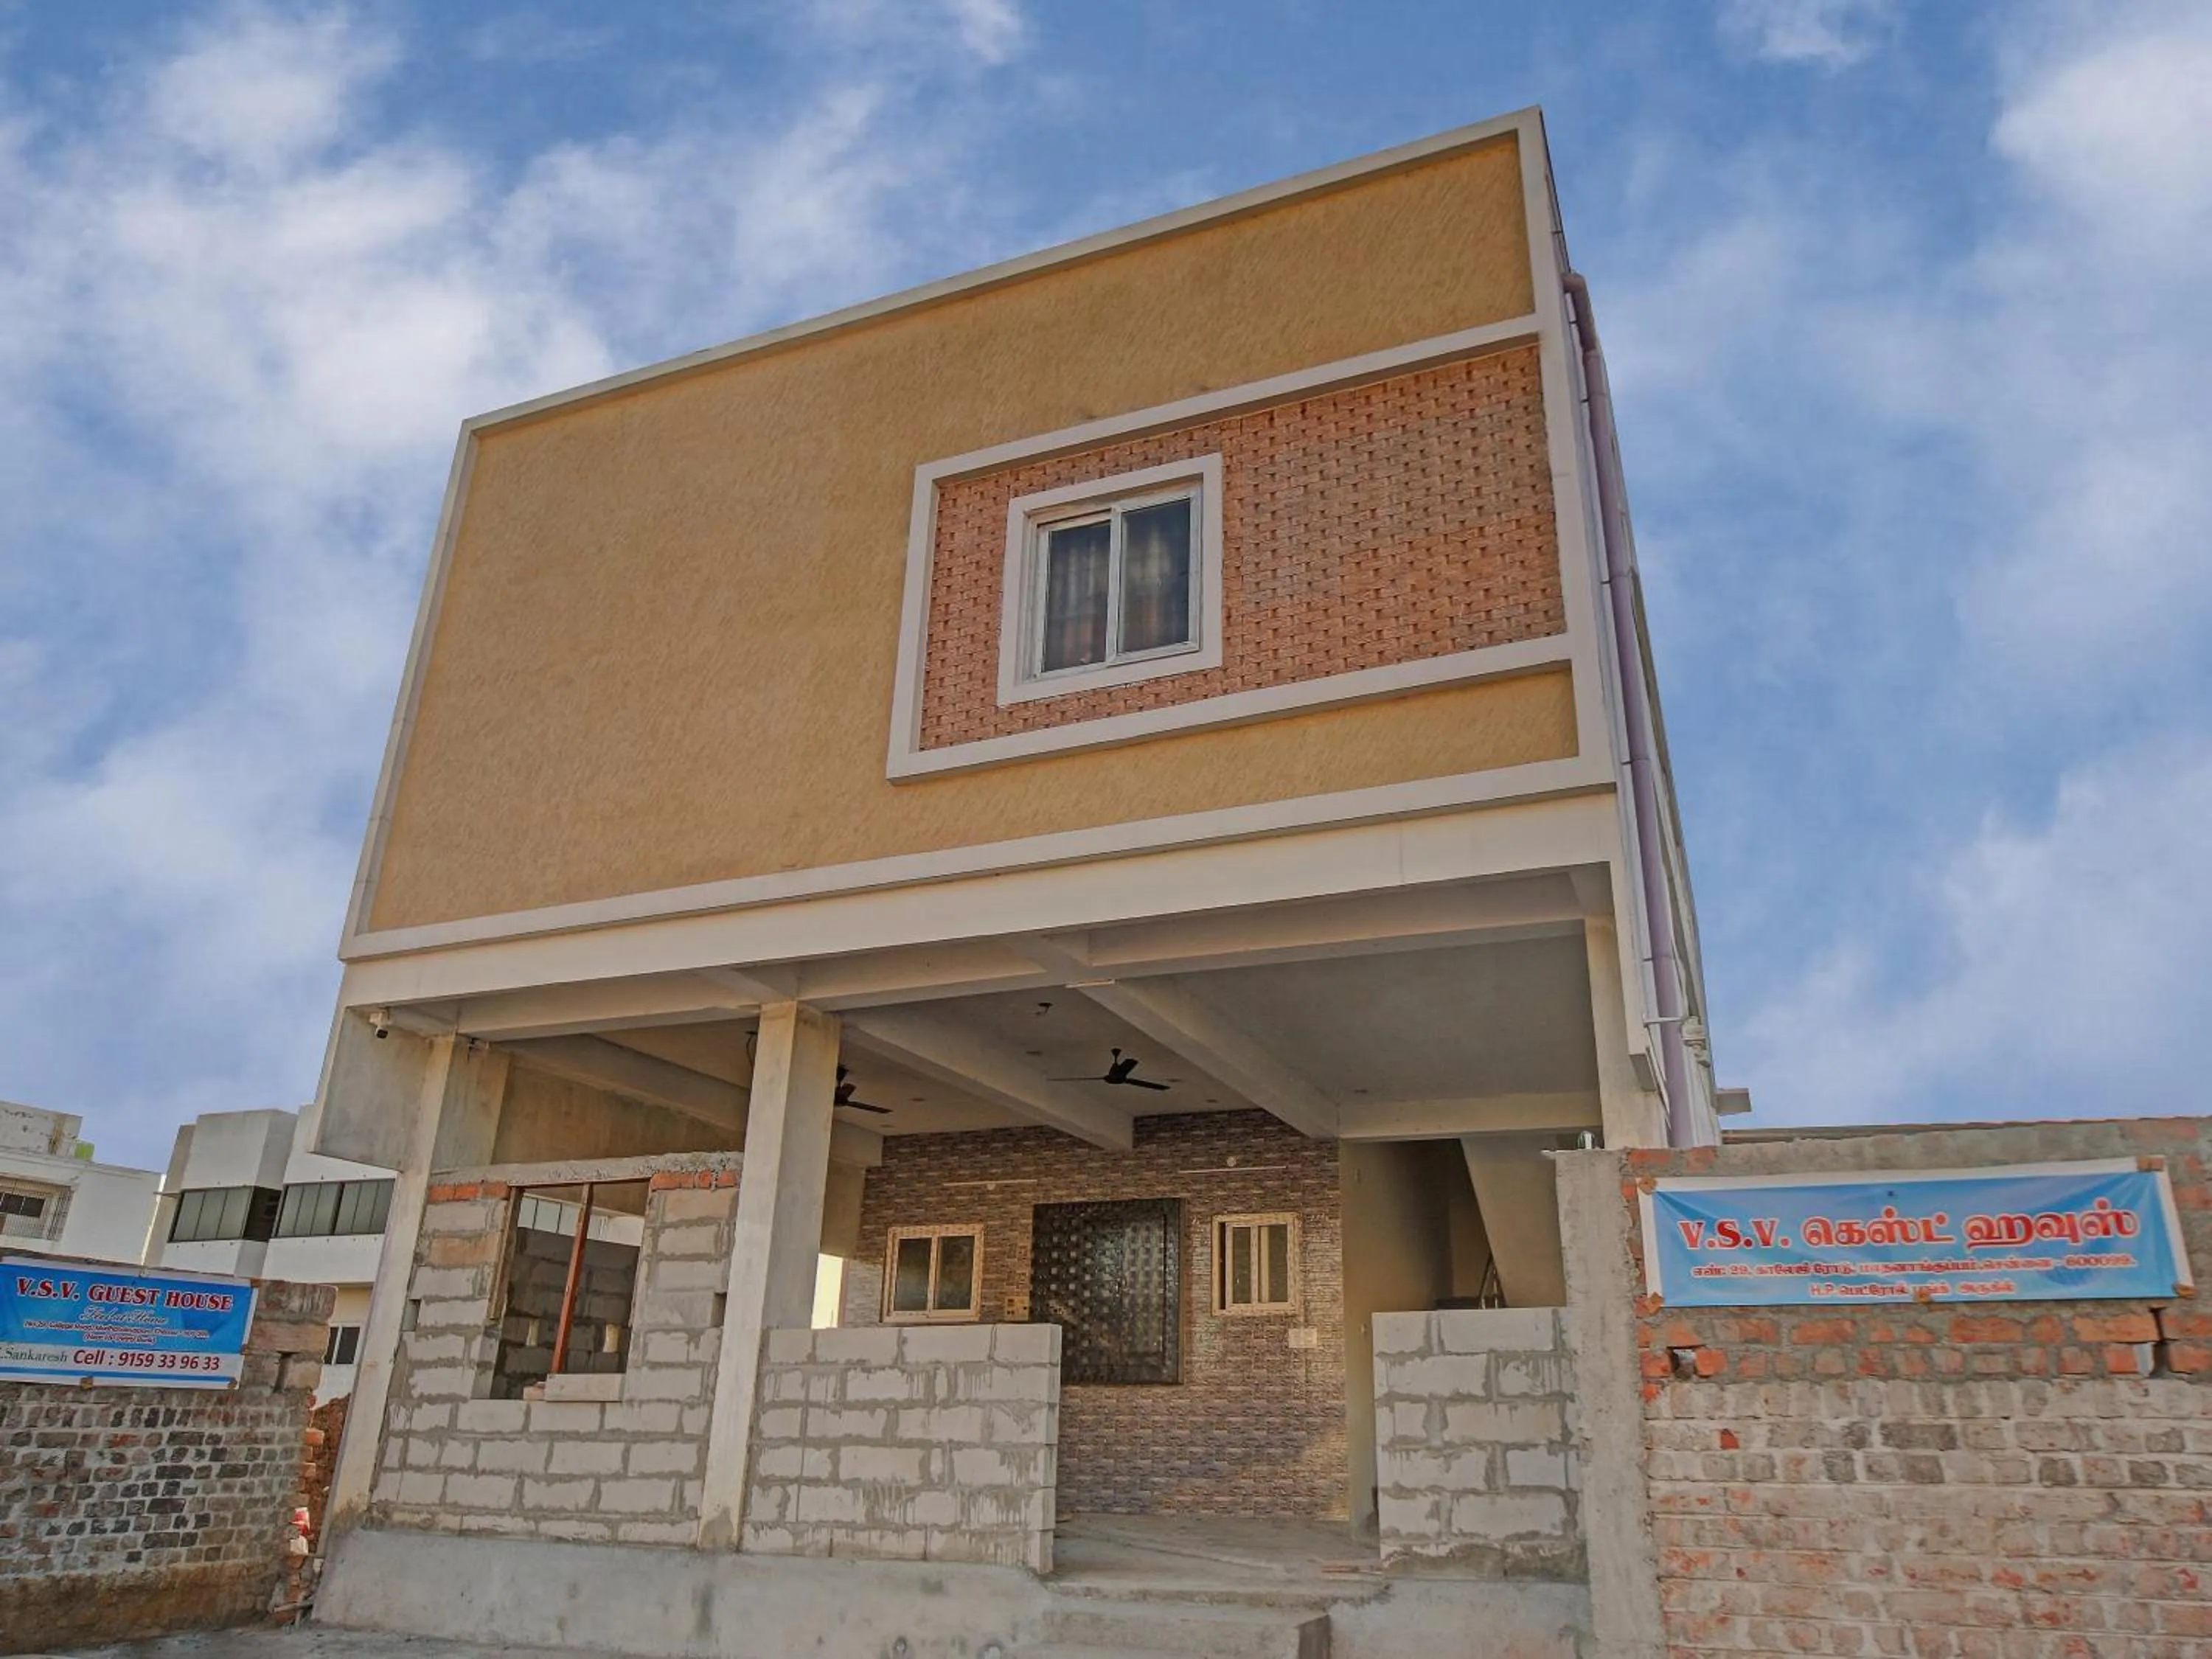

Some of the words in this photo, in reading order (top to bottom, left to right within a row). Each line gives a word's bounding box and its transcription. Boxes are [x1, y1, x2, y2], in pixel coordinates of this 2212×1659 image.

[1677, 1220, 1791, 1249] V.S.V.
[1801, 1206, 1955, 1247] கெஸ்ட்
[1963, 1197, 2138, 1250] ஹவுஸ்
[17, 1277, 80, 1300] V.S.V.
[88, 1284, 160, 1306] GUEST
[165, 1290, 234, 1311] HOUSE
[73, 1349, 106, 1365] Cell
[118, 1352, 154, 1368] 9159
[157, 1354, 176, 1368] 33
[179, 1355, 199, 1370] 96
[201, 1356, 220, 1371] 33
